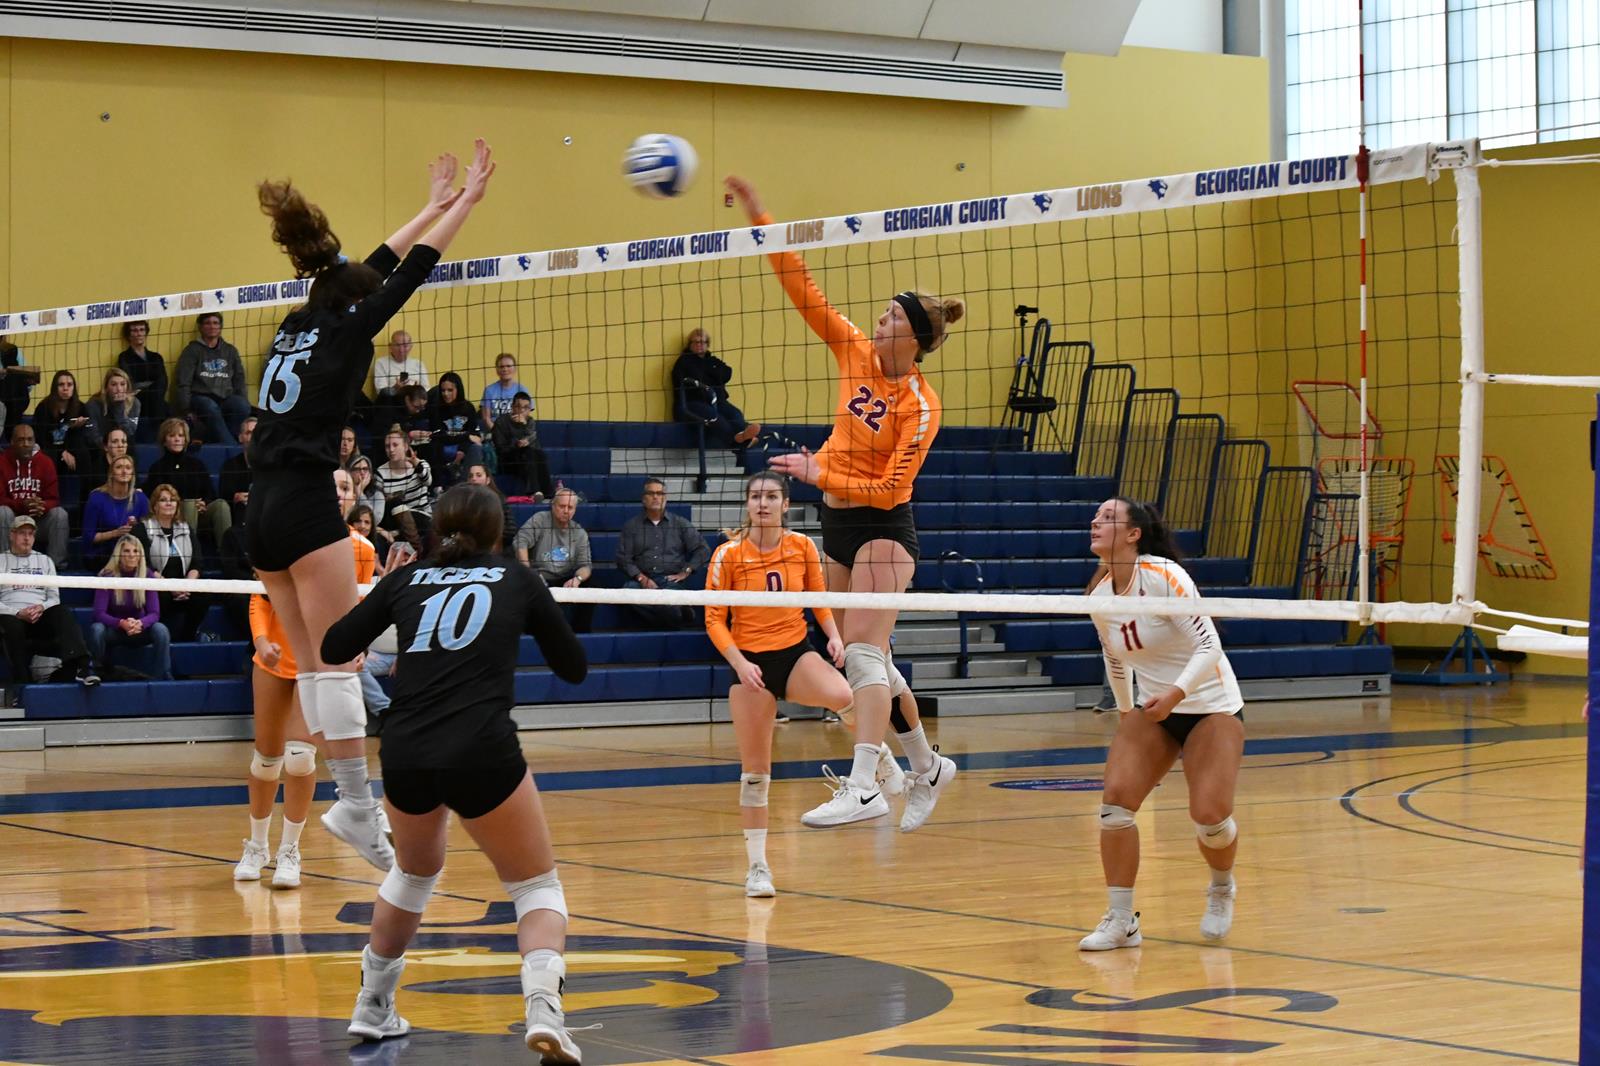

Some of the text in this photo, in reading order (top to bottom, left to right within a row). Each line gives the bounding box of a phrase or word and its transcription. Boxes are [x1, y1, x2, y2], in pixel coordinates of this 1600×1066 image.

[1195, 155, 1349, 197] GEORGIAN COURT
[1076, 184, 1123, 212] LIONS
[884, 197, 1008, 233] GEORGIAN COURT
[627, 231, 730, 262] GEORGIAN COURT
[786, 220, 825, 245] LIONS
[425, 258, 501, 284] ORGIAN COURT
[547, 249, 579, 271] LIONS
[238, 279, 310, 304] GEORGIAN COURT
[86, 298, 148, 321] GEORGIAN COURT
[258, 350, 312, 414] 15
[847, 385, 888, 434] 22
[8, 476, 41, 492] TEMPLE
[409, 566, 507, 586] TIGERS
[405, 583, 493, 653] 10
[1120, 619, 1144, 652] 11
